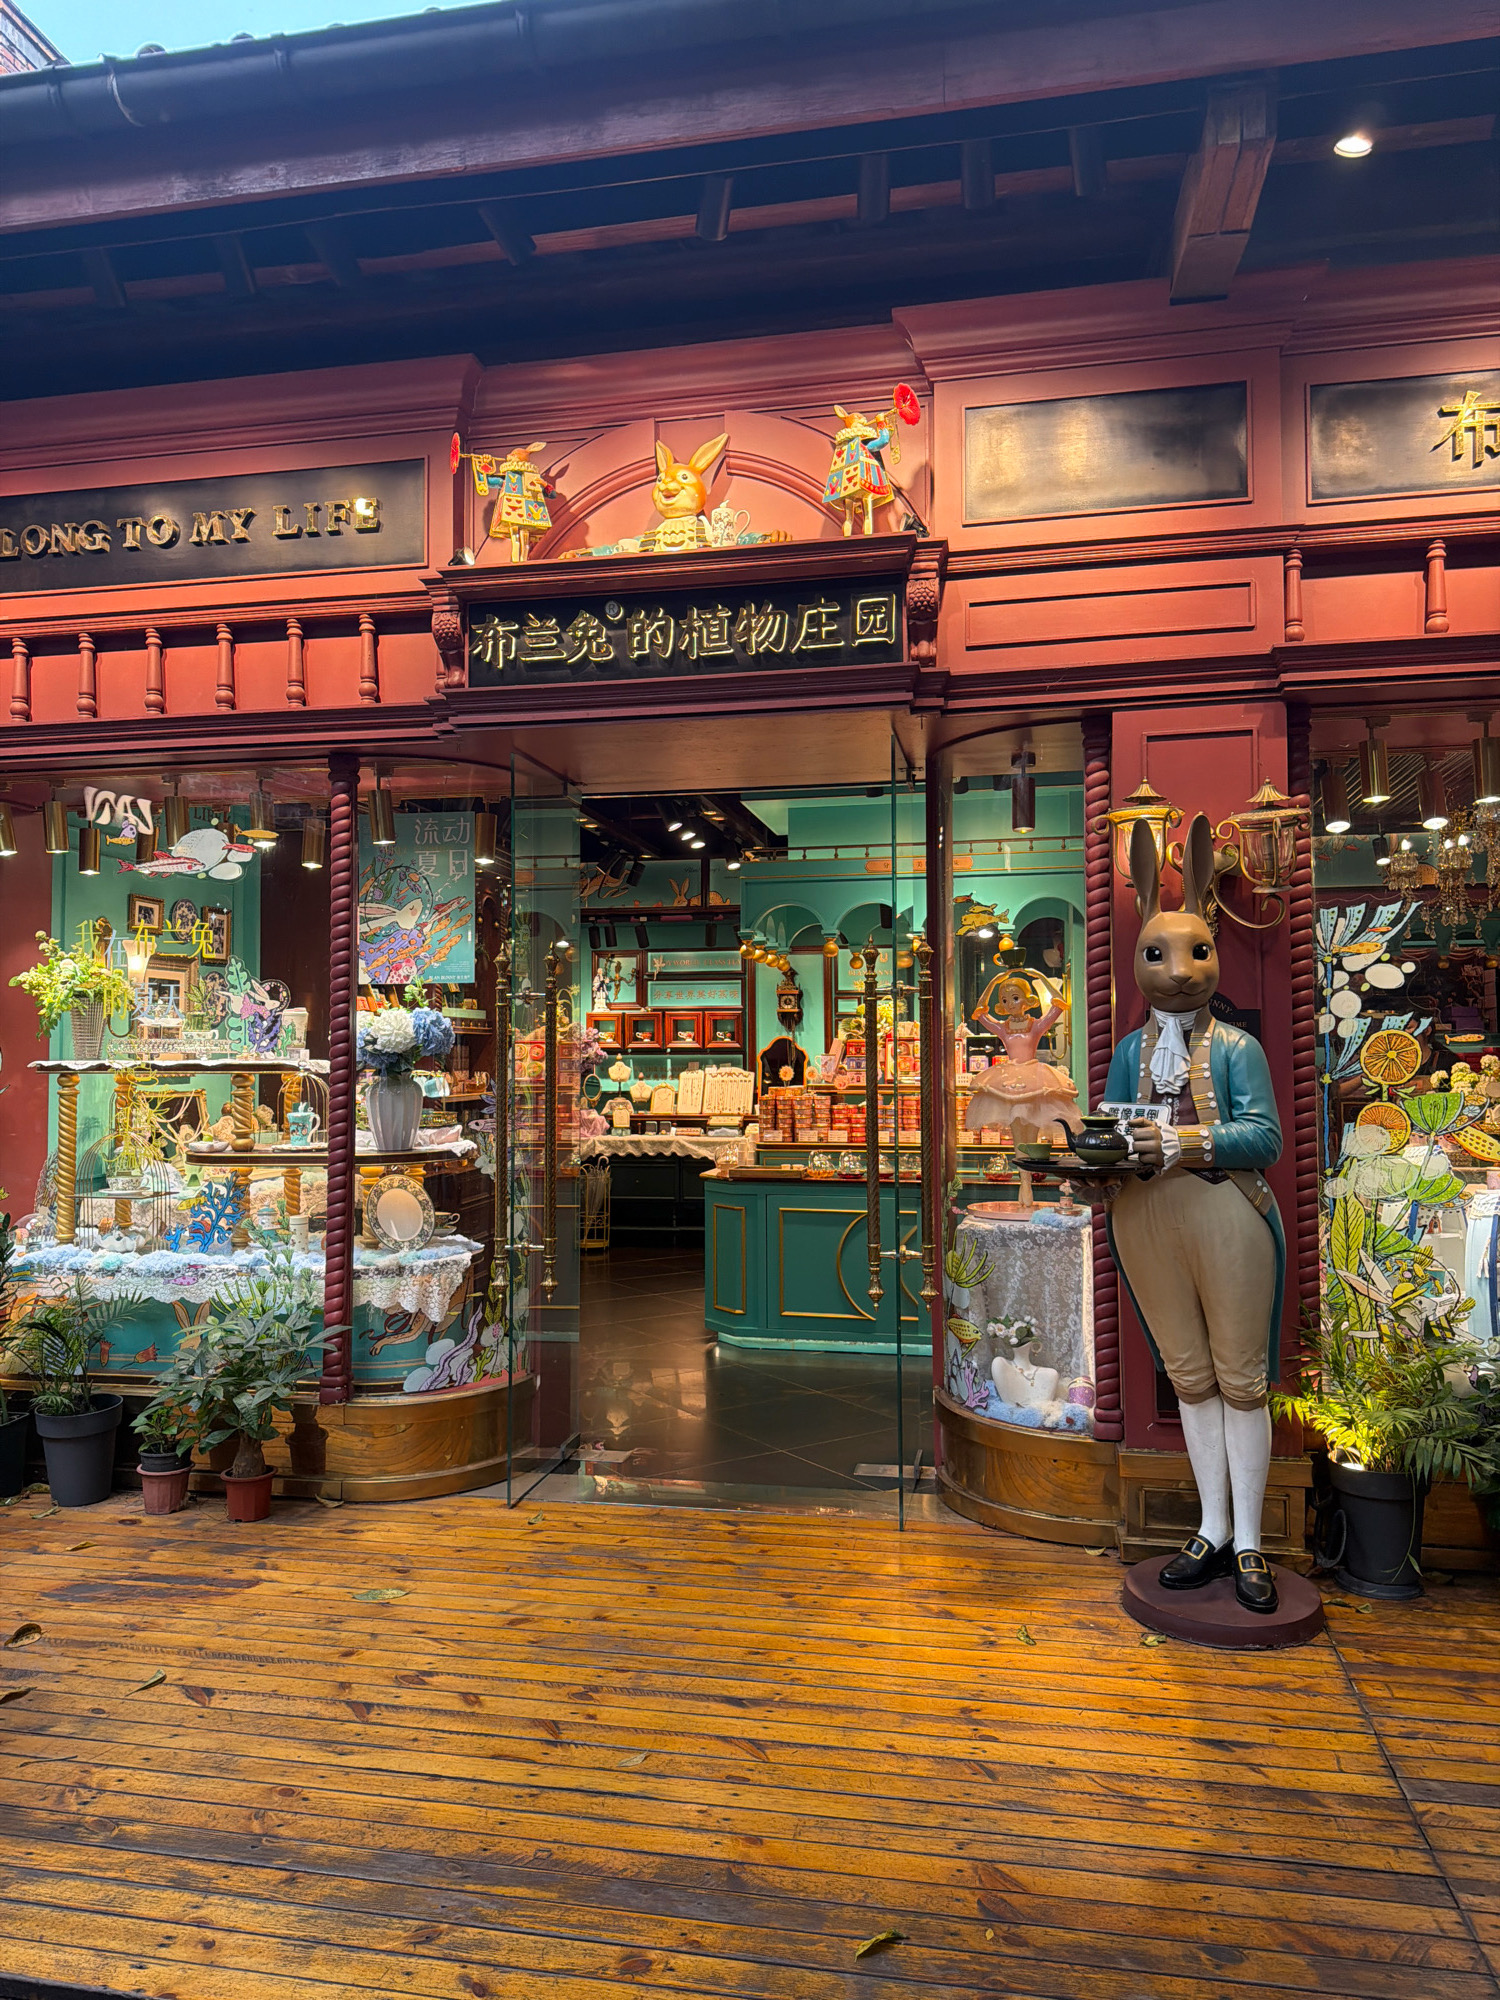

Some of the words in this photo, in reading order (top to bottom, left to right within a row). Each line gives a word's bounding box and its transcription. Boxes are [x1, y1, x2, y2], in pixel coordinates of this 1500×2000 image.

[117, 514, 179, 550] TO
[189, 507, 256, 544] MY
[272, 497, 380, 537] LIFE
[414, 816, 471, 846] 流动
[414, 849, 468, 878] 夏日
[74, 918, 216, 967] 我在布兰兔
[102, 982, 185, 1021] 的夏天
